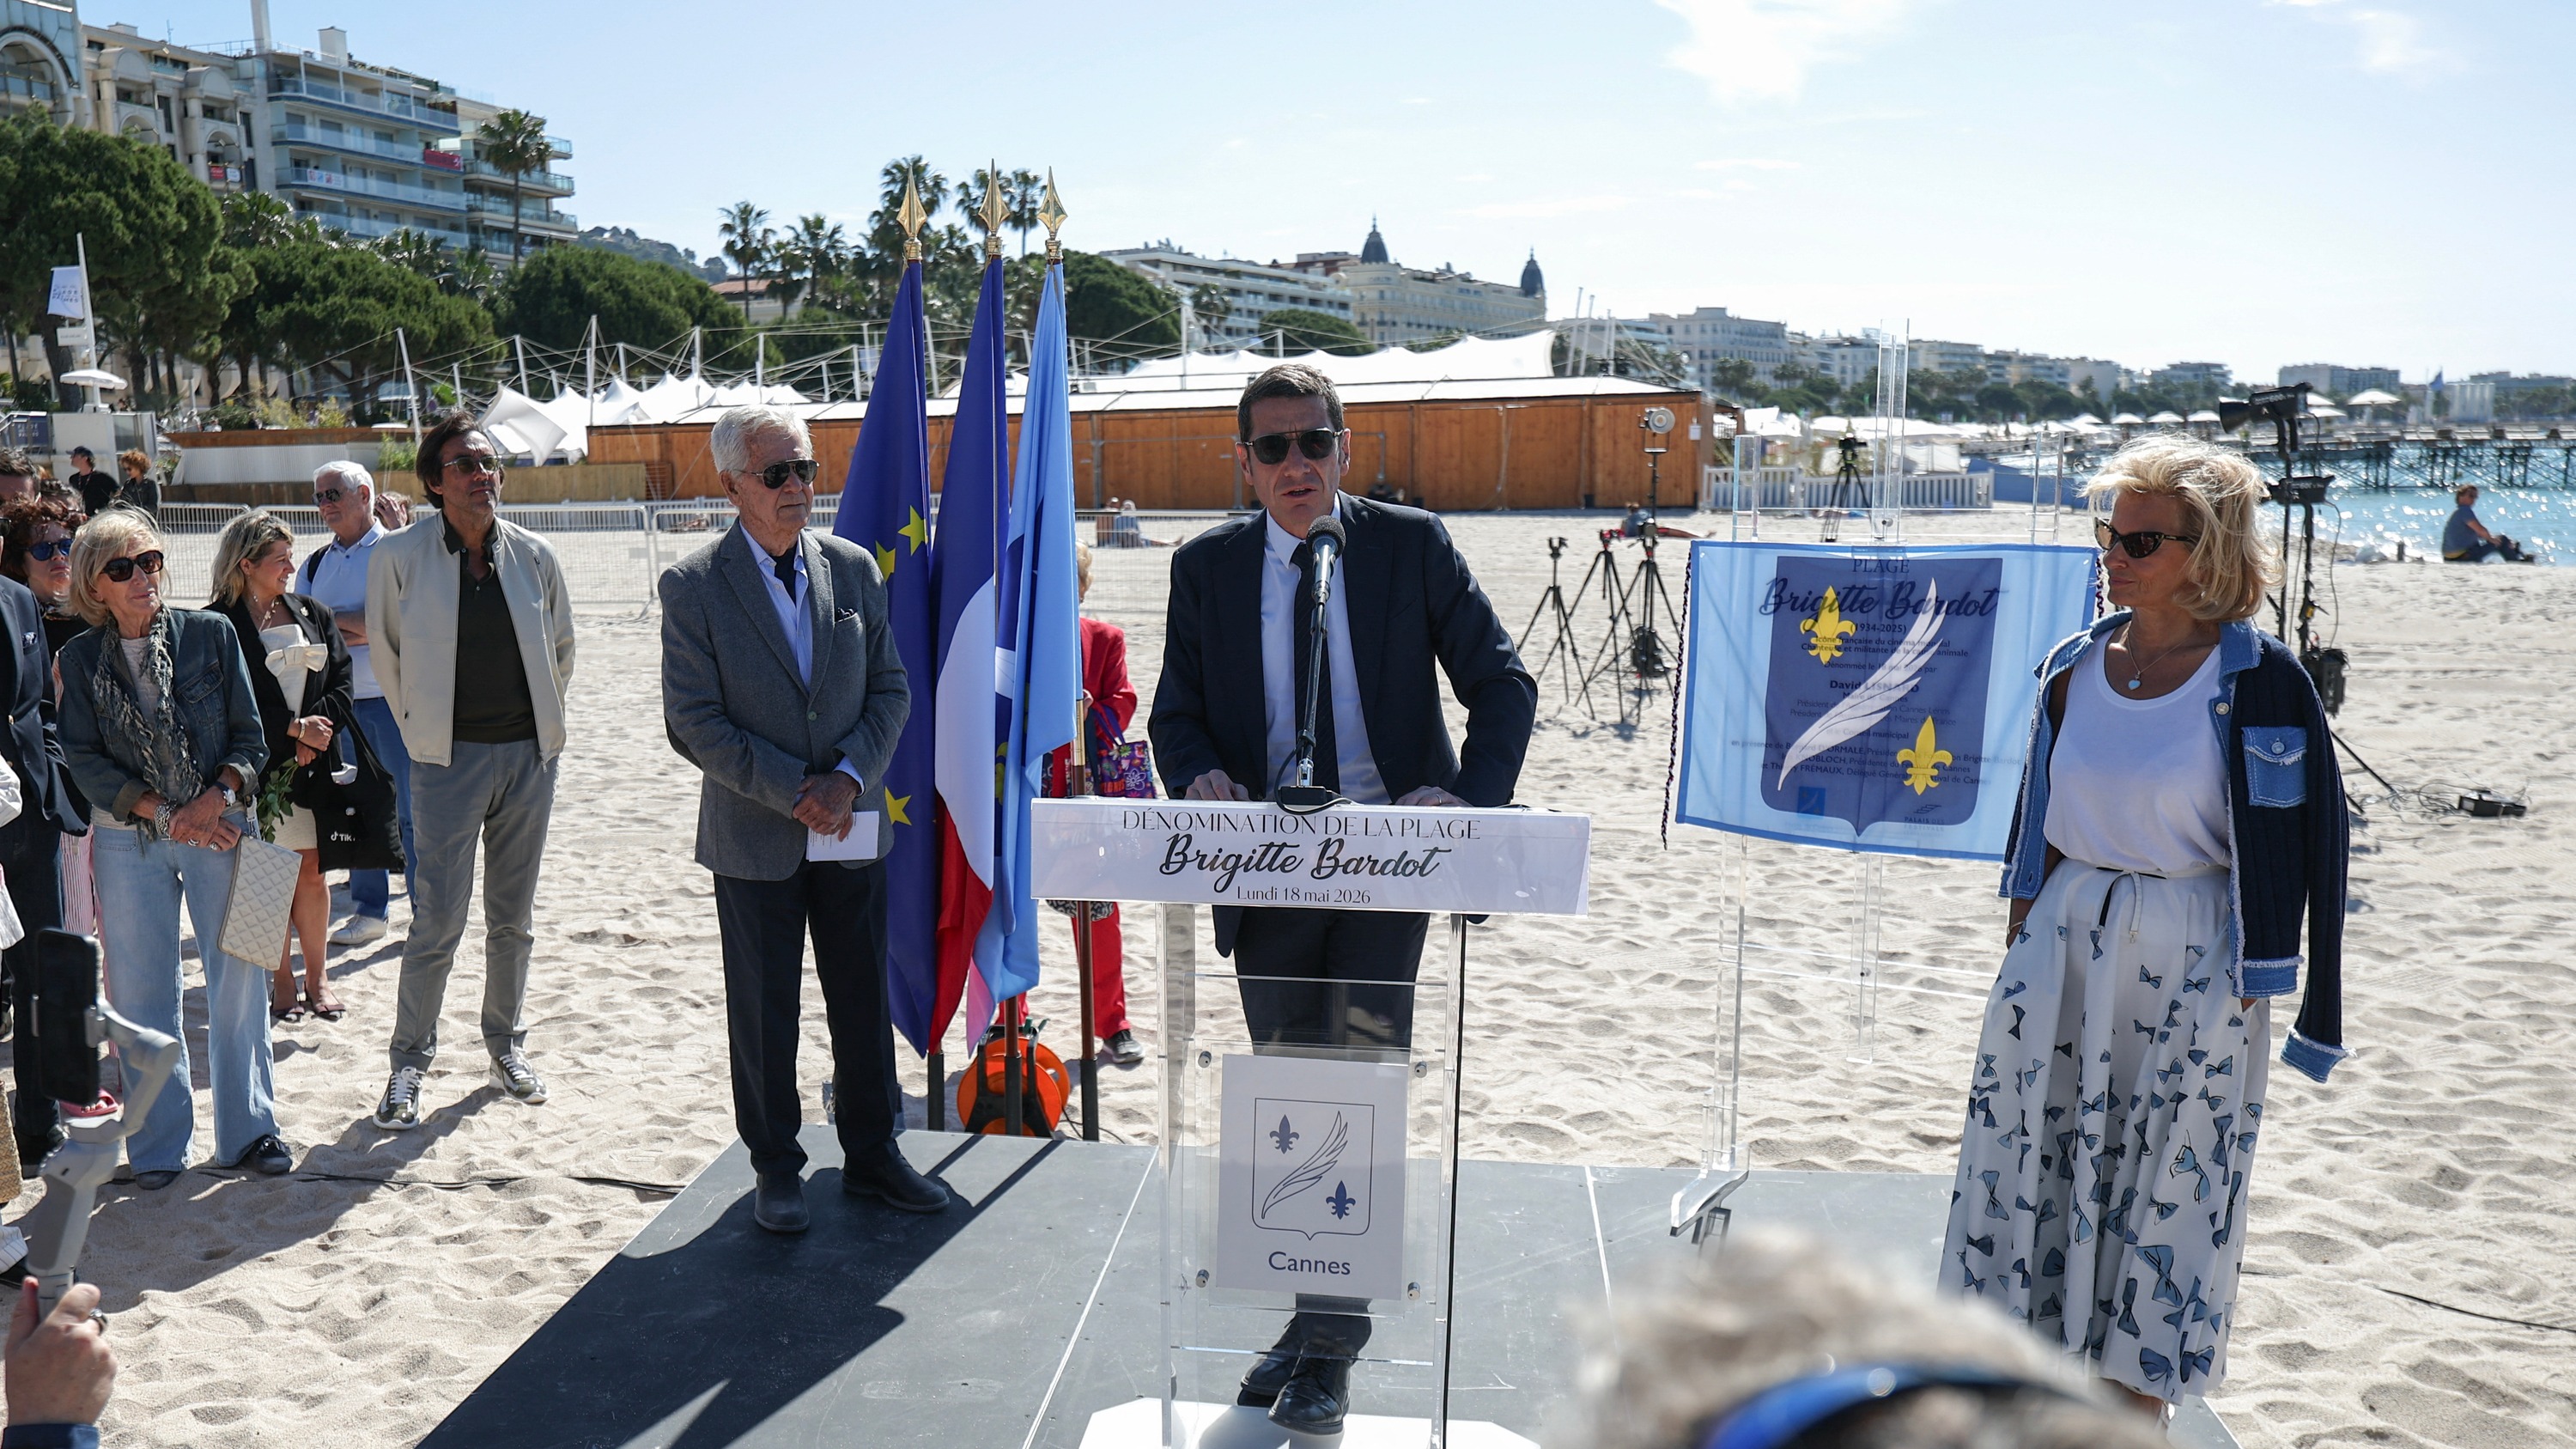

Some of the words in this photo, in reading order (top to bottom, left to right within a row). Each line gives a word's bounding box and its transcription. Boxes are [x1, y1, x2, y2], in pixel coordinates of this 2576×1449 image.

[1852, 559, 1910, 574] PLAGE
[1759, 577, 1880, 631] Brigitte
[1885, 580, 2009, 619] Bardot
[1851, 623, 1907, 635] (1934-2025)
[1839, 636, 1873, 645] française
[1855, 645, 1888, 654] militante
[1937, 648, 1968, 657] animale
[1868, 662, 1875, 671] le
[1829, 679, 1862, 690] David
[1797, 699, 1829, 708] Président
[1899, 704, 1927, 714] Cannes
[1790, 709, 1822, 717] Président
[1894, 714, 1917, 723] Maires
[1873, 731, 1909, 740] municipal
[1849, 757, 1888, 767] Présidente
[1942, 764, 1971, 773] Cannes
[1123, 808, 1317, 835] DÉNOMINATION
[1325, 816, 1357, 836] DE
[1364, 818, 1394, 837] LA
[1401, 818, 1480, 839] PLAGE
[1159, 833, 1304, 893] Brigitte
[1310, 837, 1452, 880] Bardot
[1237, 886, 1278, 901] Lundi
[1284, 886, 1300, 902] 18
[1304, 889, 1330, 903] mai
[1334, 889, 1370, 904] 2026
[1268, 1251, 1352, 1275] Cannes
